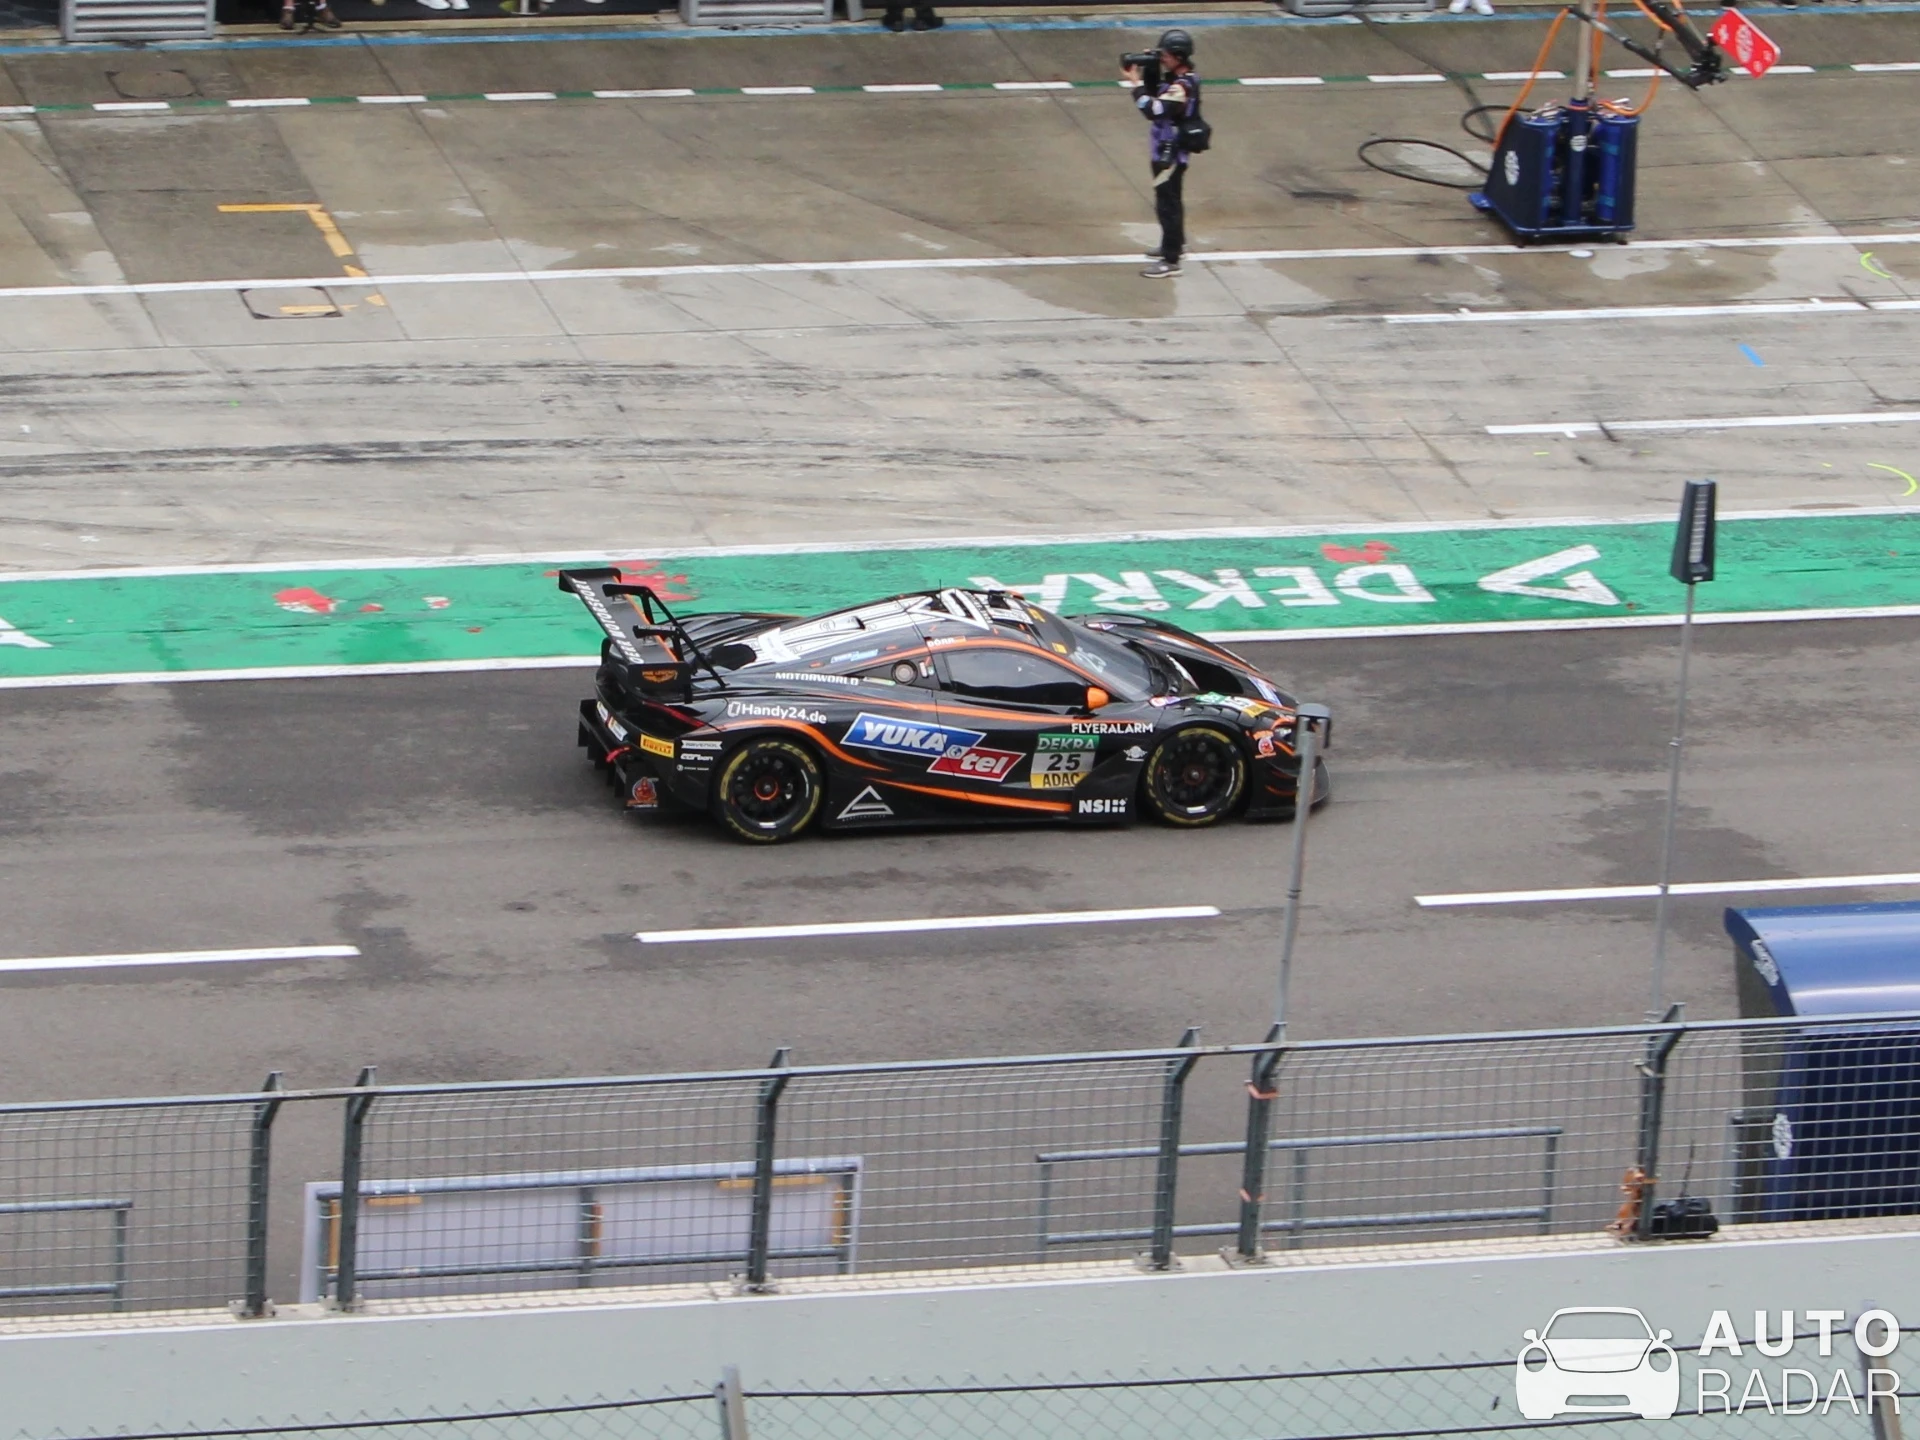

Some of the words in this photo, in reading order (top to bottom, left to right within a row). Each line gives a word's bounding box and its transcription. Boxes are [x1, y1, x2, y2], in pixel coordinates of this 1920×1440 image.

[968, 563, 1434, 614] DEKRA
[775, 672, 859, 686] MOTORWORLD
[741, 704, 827, 724] Handy24.de
[1071, 723, 1153, 734] FLYERALARM
[1037, 738, 1095, 750] DEKRA
[1047, 753, 1081, 771] 25
[1043, 772, 1079, 787] ADAC
